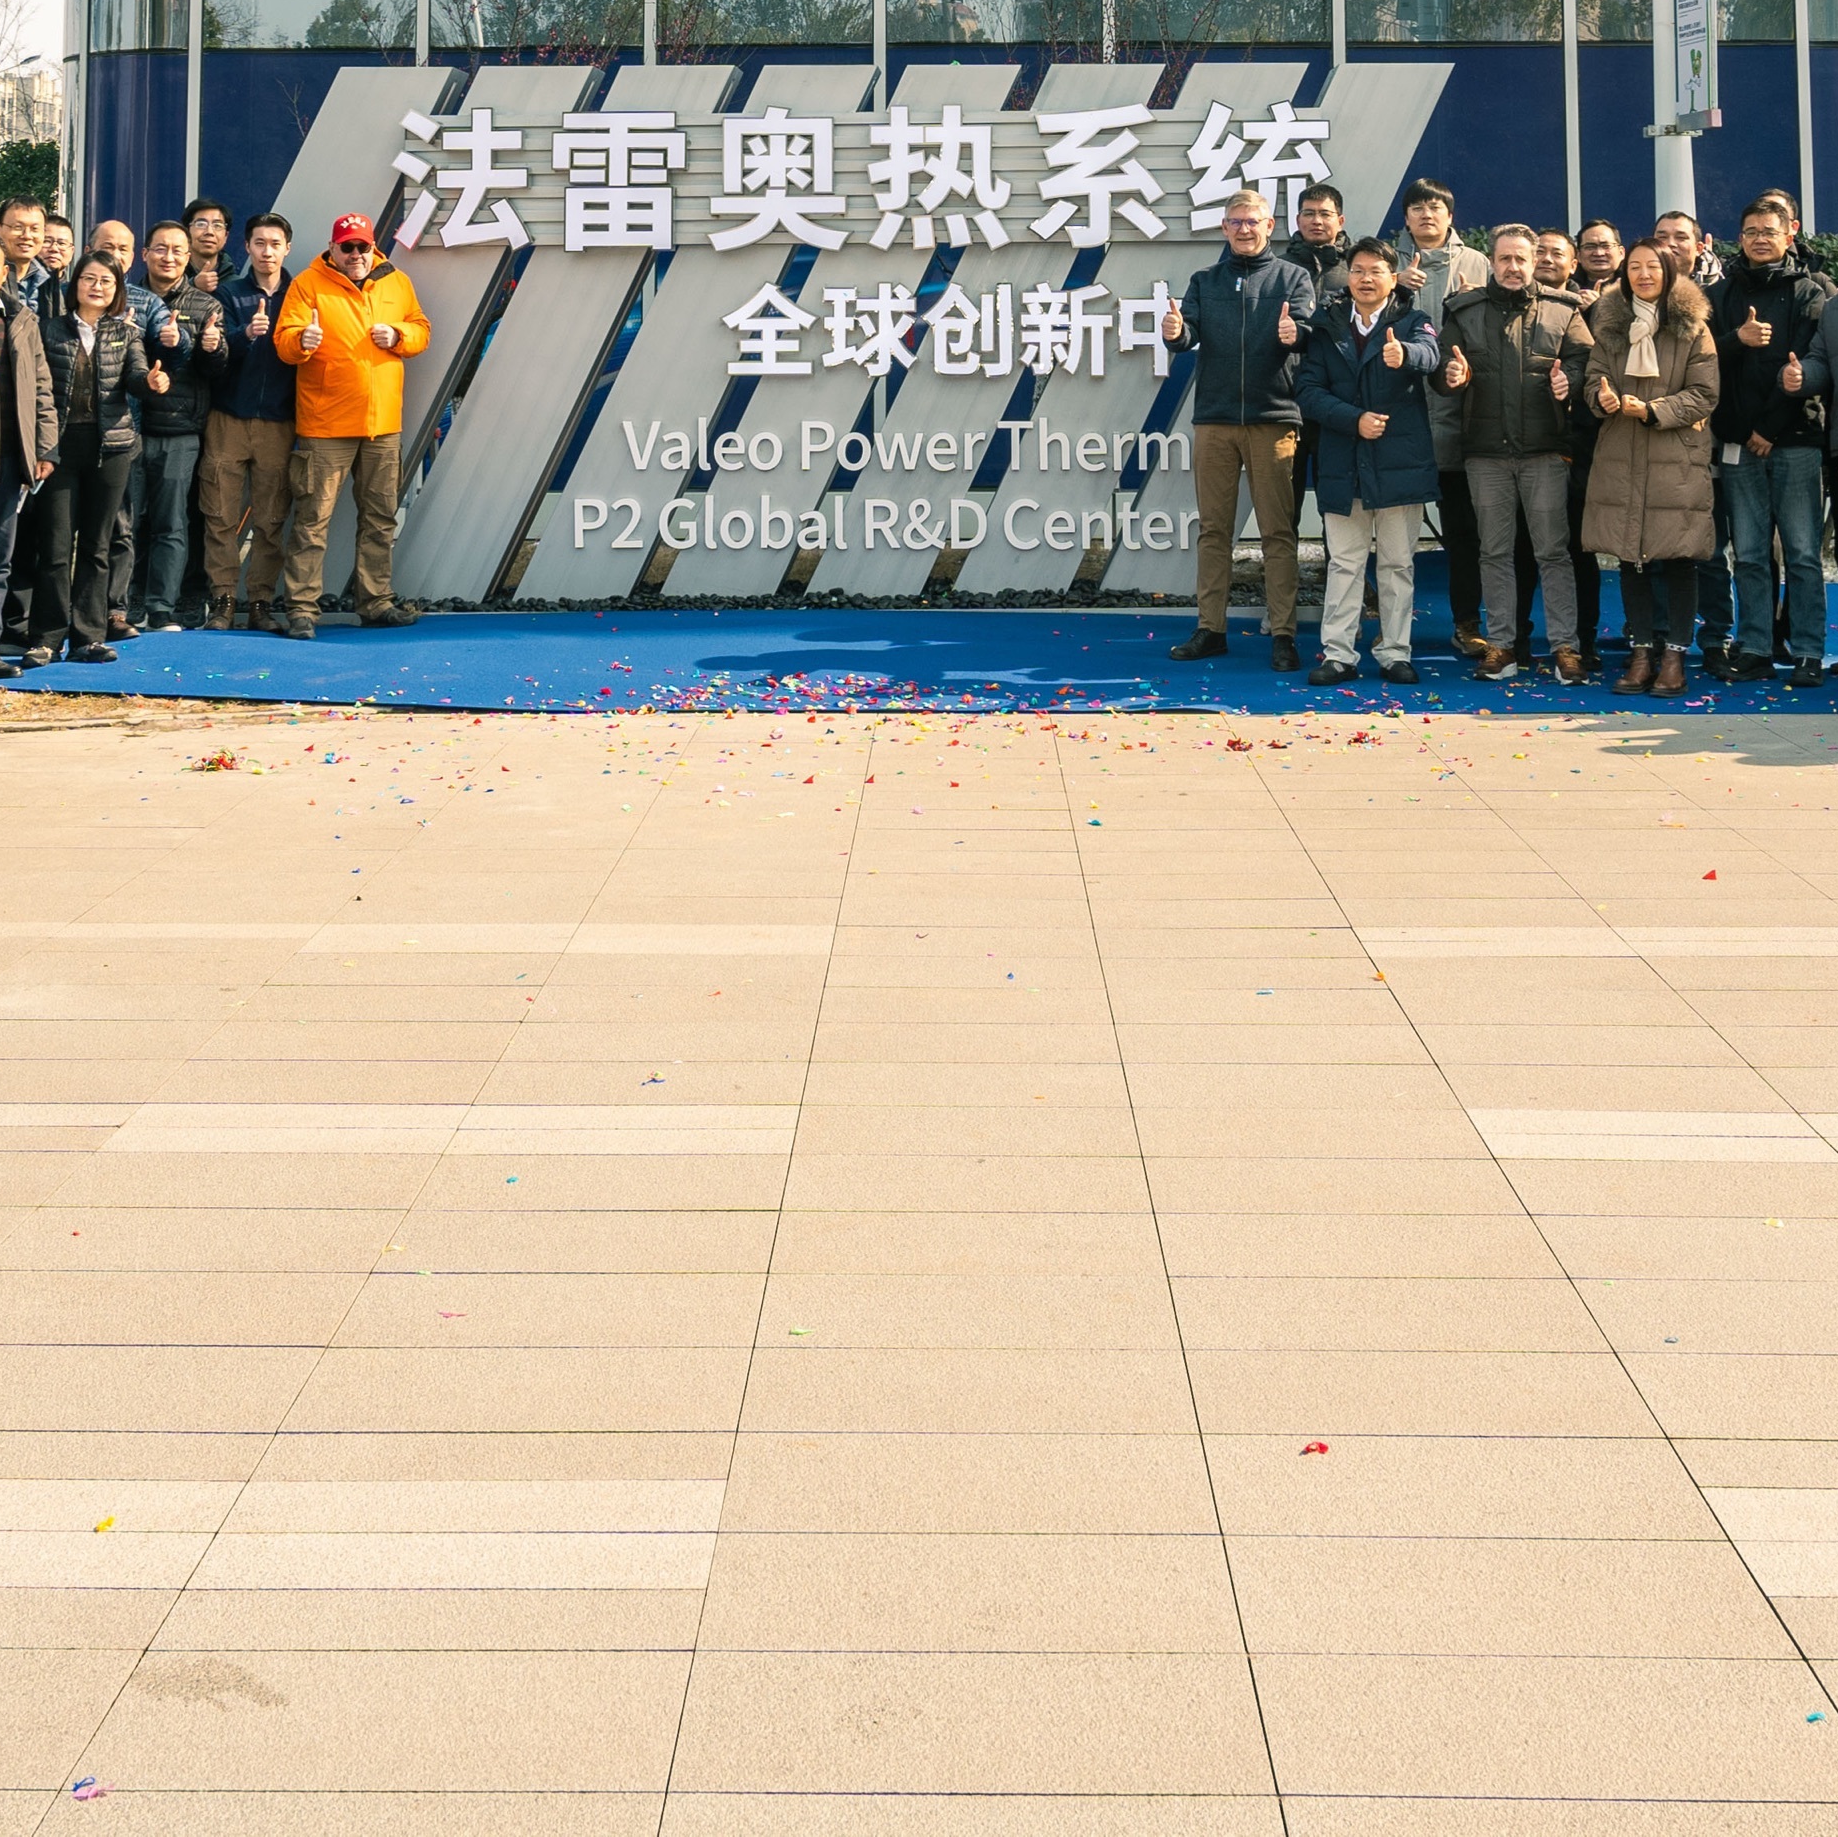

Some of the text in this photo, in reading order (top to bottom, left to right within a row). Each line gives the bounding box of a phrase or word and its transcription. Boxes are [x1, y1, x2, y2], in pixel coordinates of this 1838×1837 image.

[392, 101, 1331, 251] 法雷奥热系统
[622, 416, 1191, 471] Valeo Power Therm
[574, 494, 1200, 550] P2 Global R&D Center
